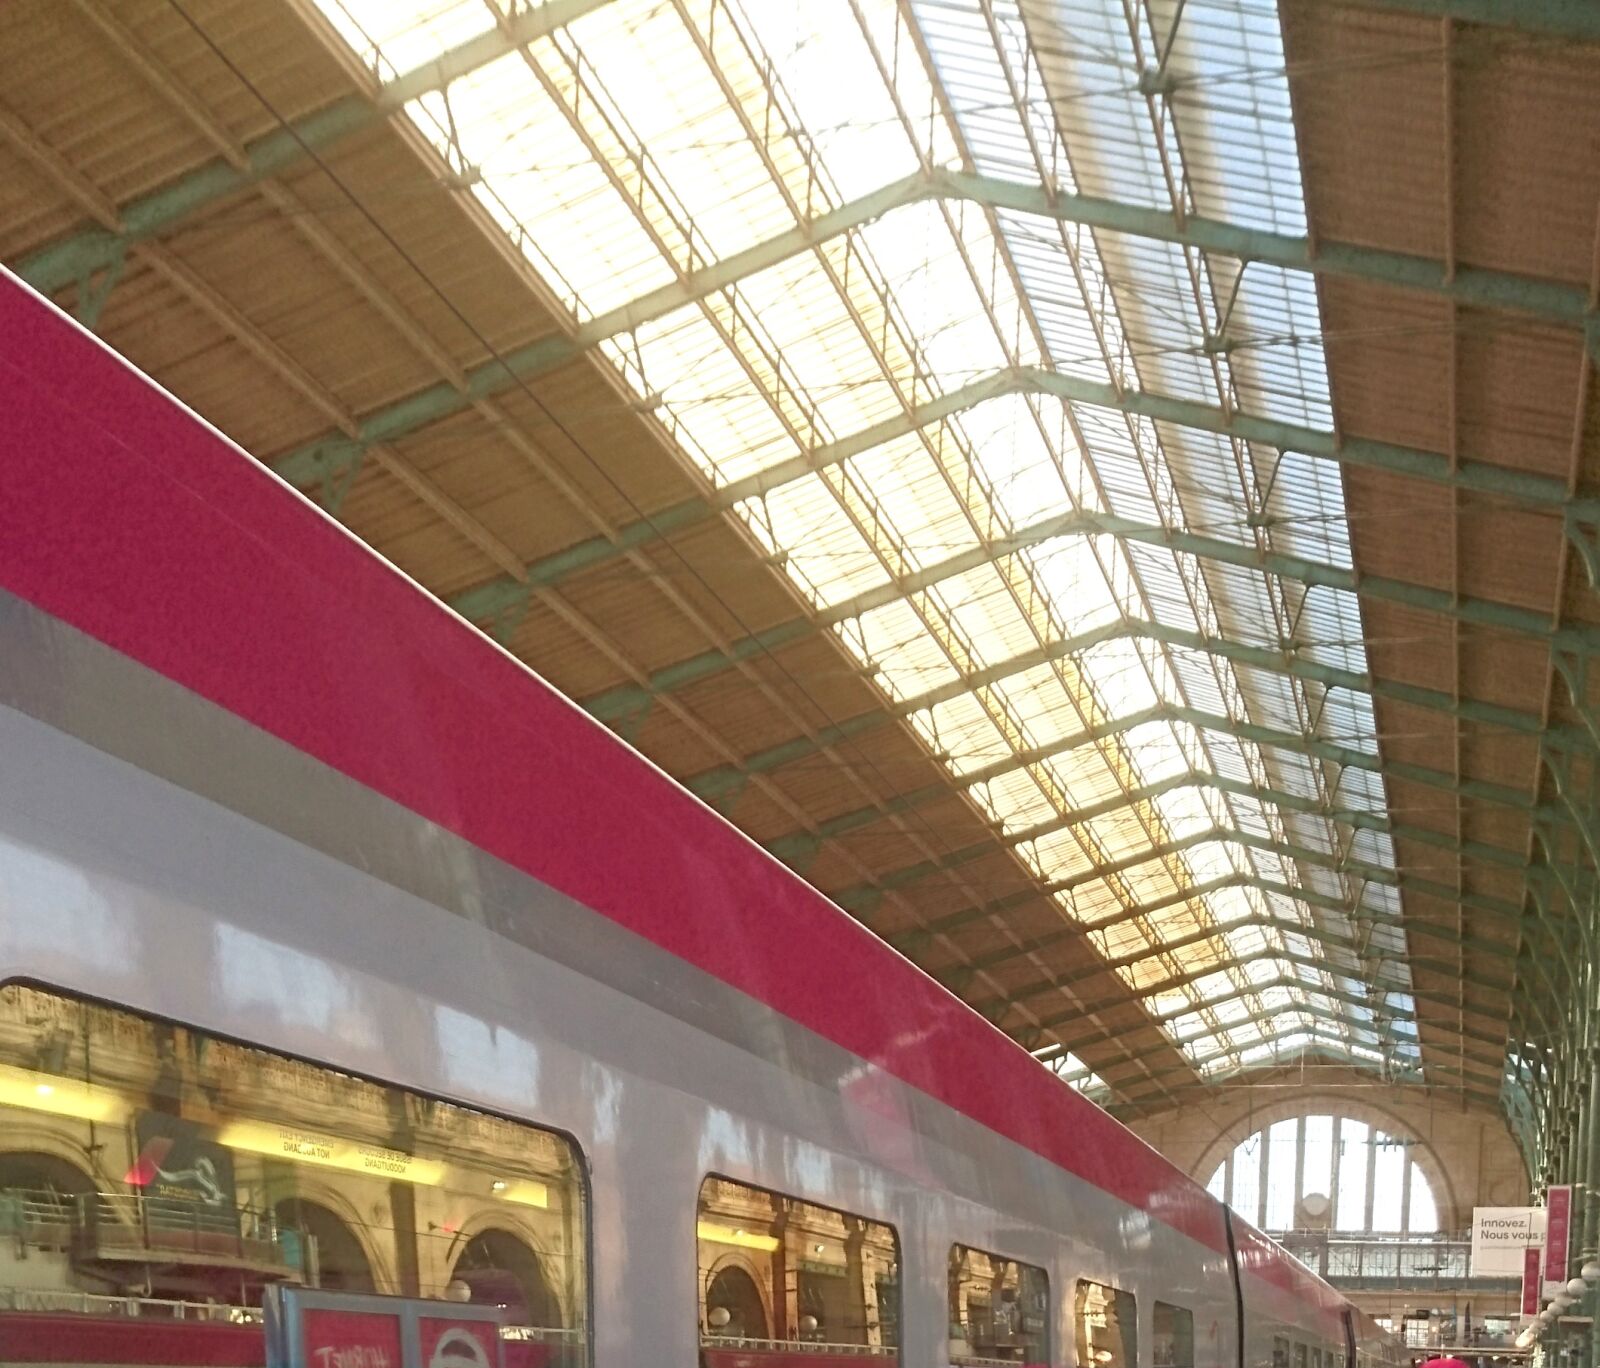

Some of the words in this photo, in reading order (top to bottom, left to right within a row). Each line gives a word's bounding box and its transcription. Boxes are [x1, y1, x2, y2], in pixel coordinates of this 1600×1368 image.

[1480, 1217, 1527, 1228] Innovez.
[1480, 1229, 1509, 1240] Nous
[1511, 1231, 1539, 1240] vous
